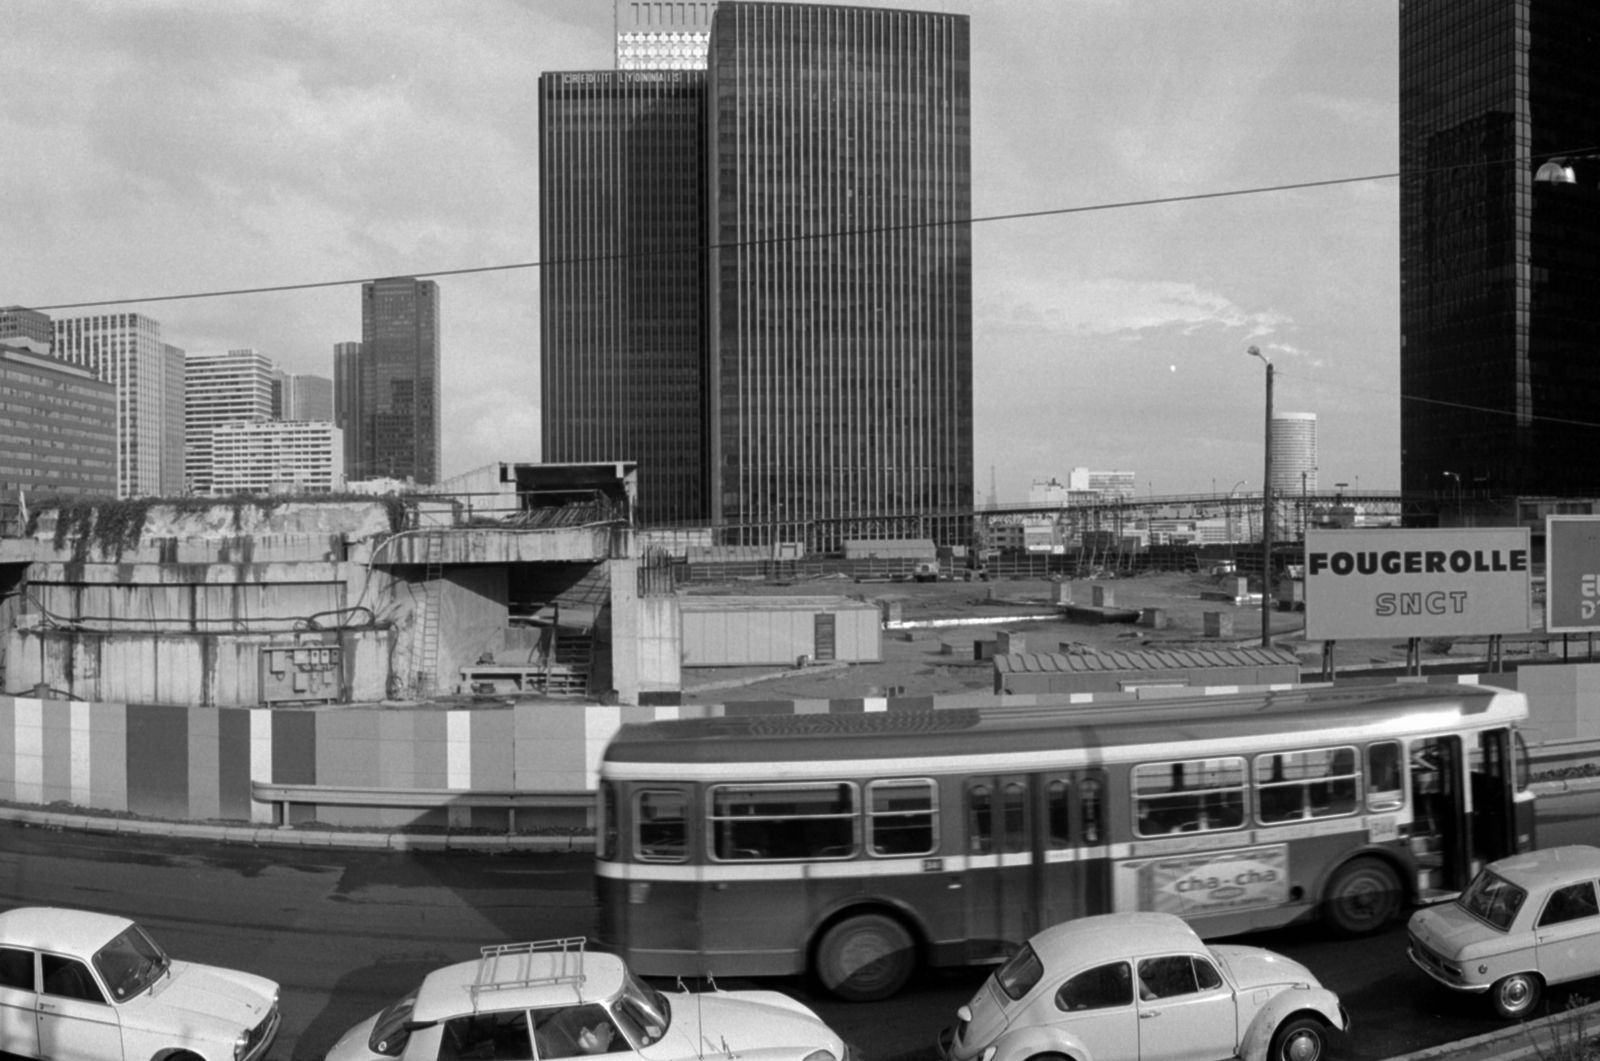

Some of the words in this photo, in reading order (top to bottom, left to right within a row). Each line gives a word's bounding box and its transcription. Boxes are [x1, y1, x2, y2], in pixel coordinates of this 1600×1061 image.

[564, 73, 610, 84] CREDIT
[619, 72, 681, 83] LYONNAIS
[1309, 550, 1527, 575] FOUGEROLLE
[1376, 591, 1467, 616] SNCT
